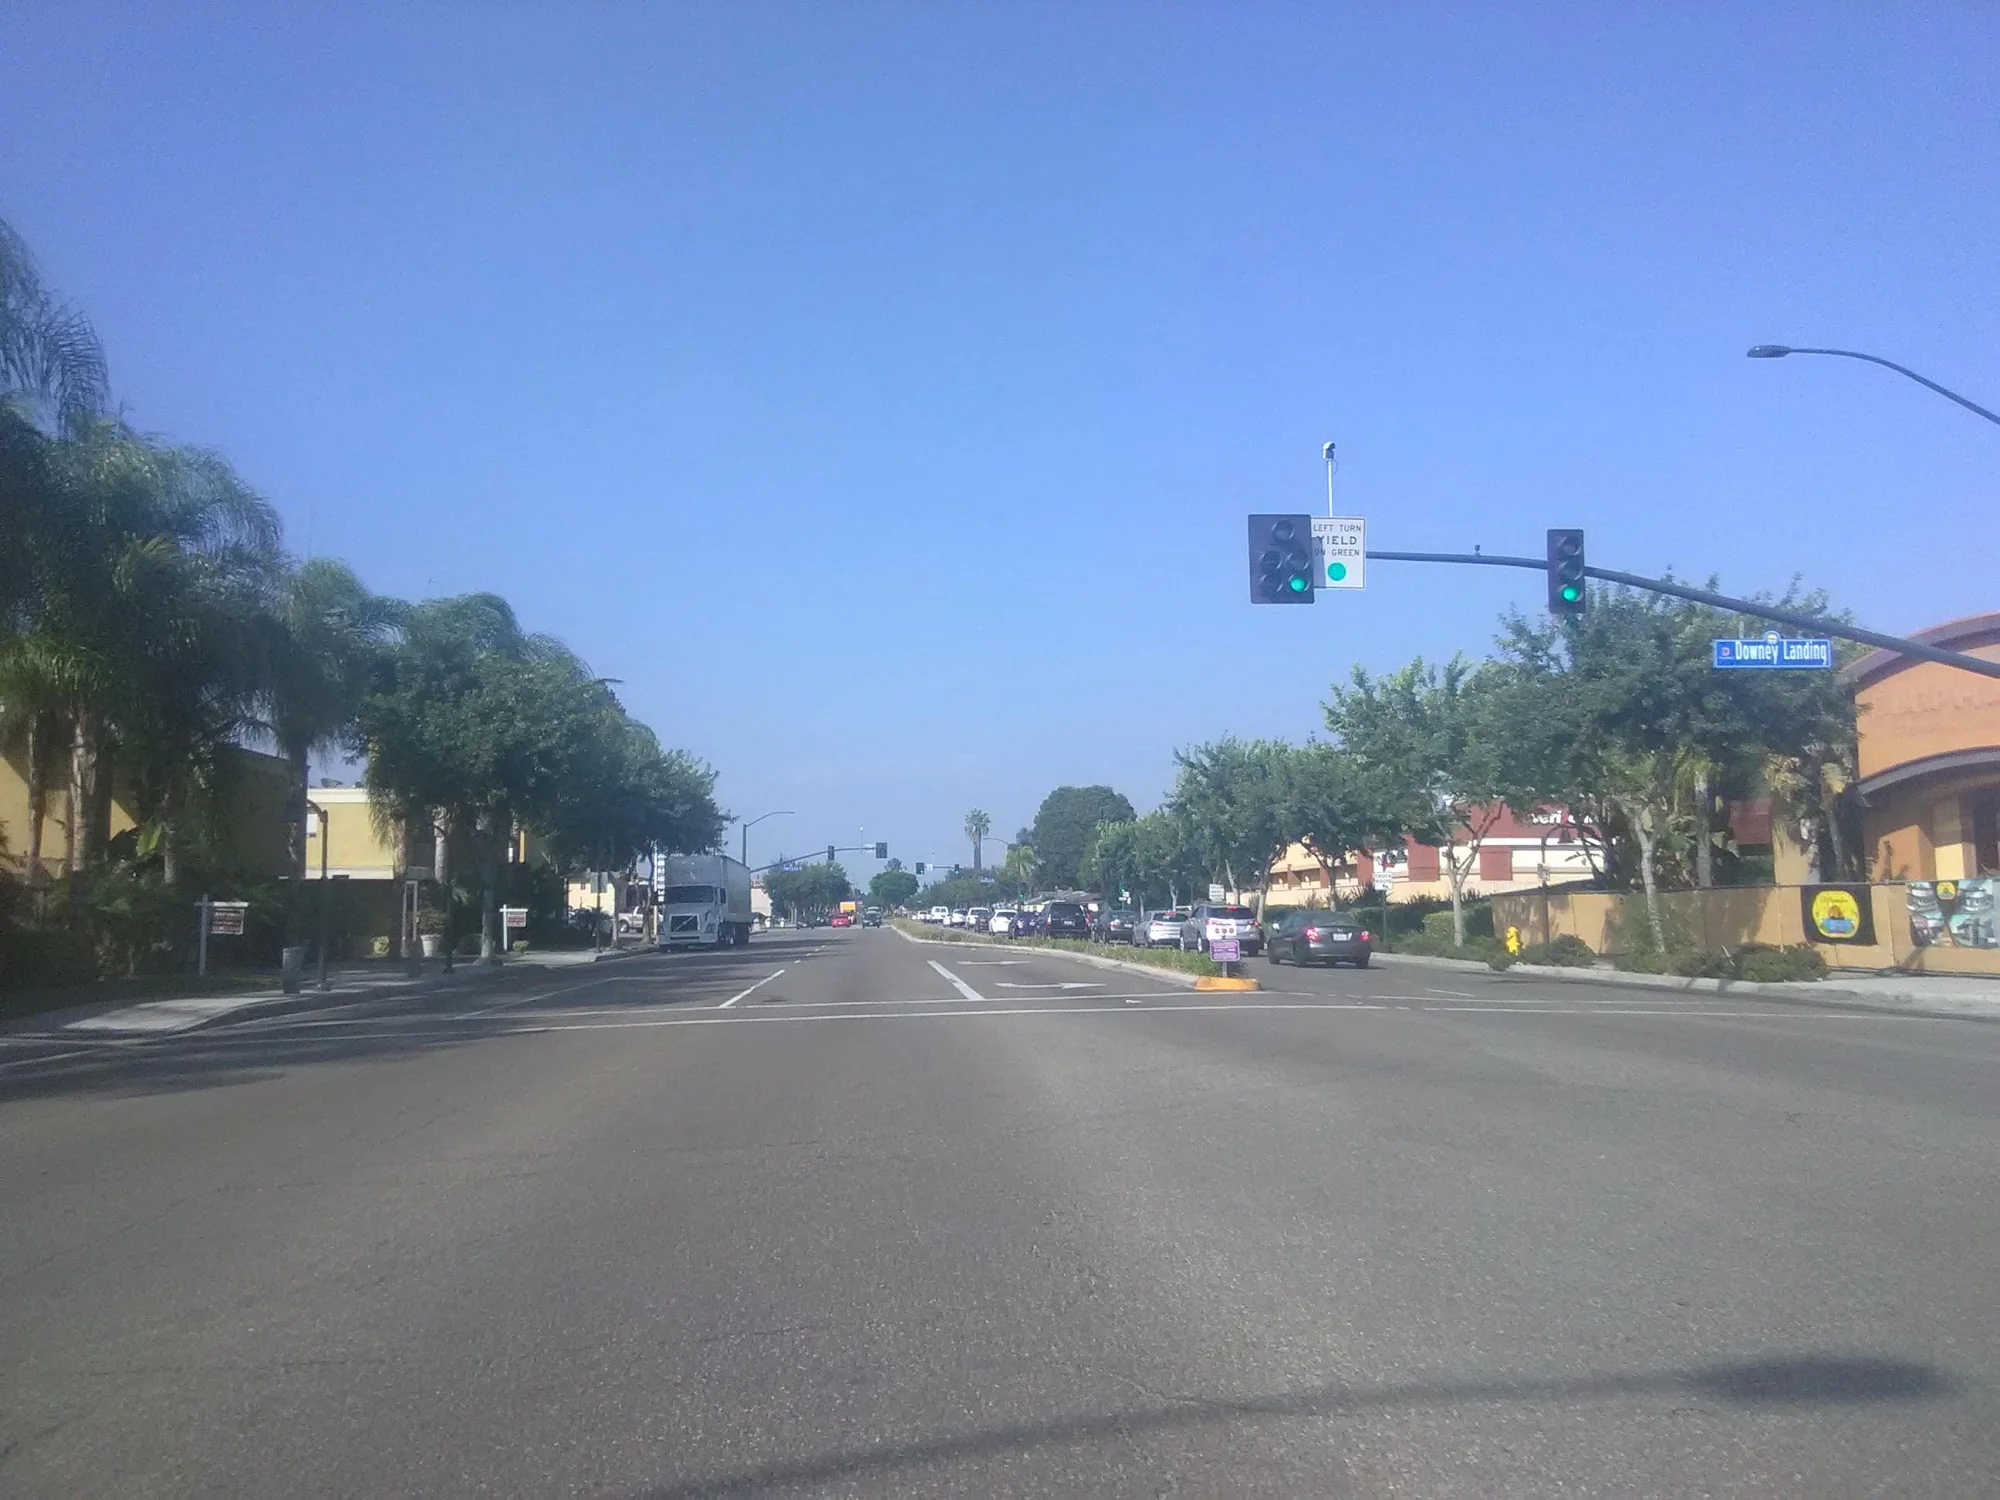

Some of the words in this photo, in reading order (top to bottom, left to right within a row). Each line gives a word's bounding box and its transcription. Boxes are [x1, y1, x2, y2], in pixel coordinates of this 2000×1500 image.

[1313, 524, 1334, 532] LEFT
[1340, 524, 1362, 532] TURN
[1317, 535, 1357, 545] YIELD
[1332, 549, 1360, 557] GREEN
[1735, 640, 1779, 665] Downey
[1783, 640, 1827, 666] Landing
